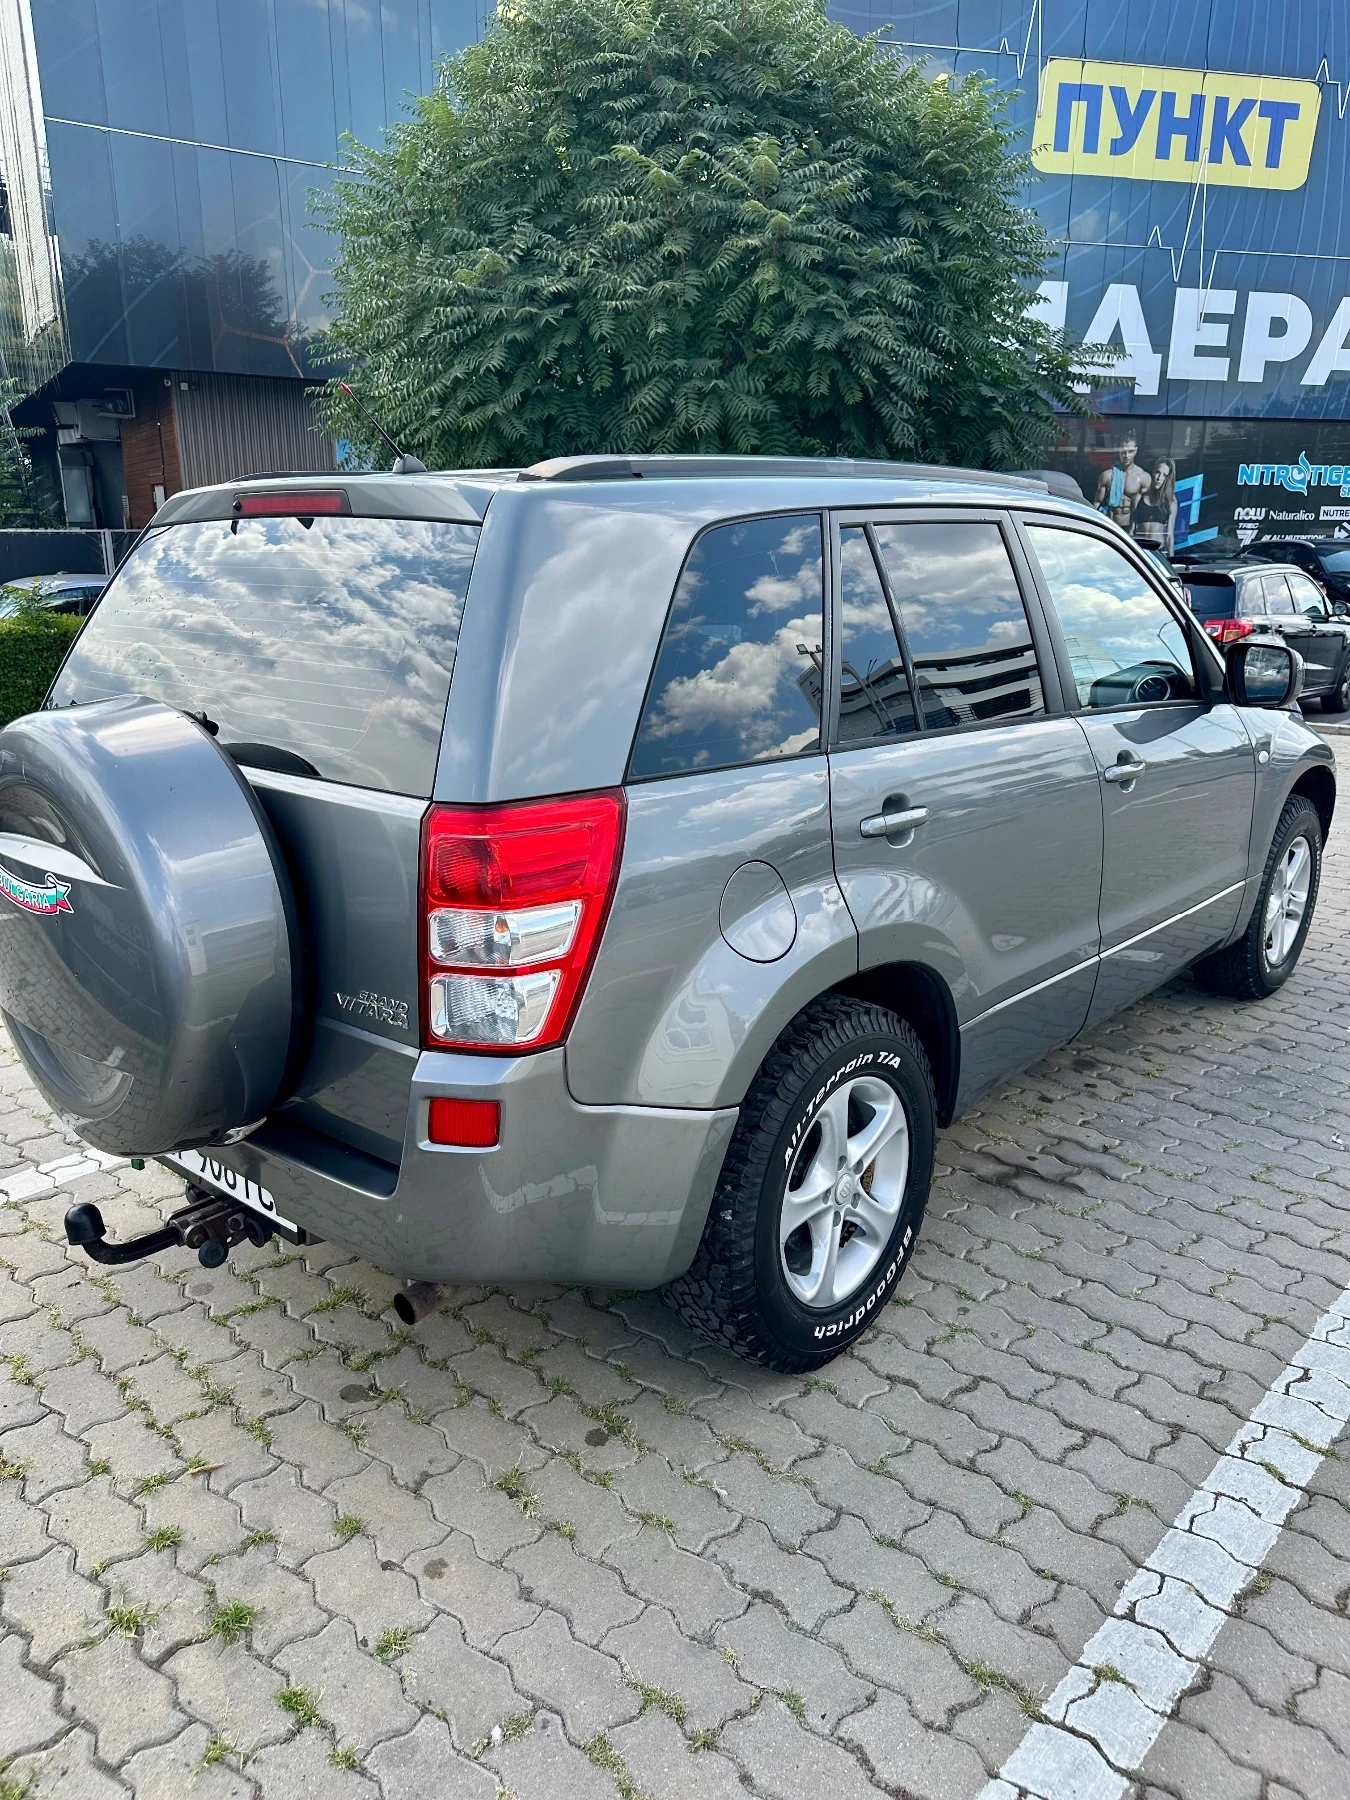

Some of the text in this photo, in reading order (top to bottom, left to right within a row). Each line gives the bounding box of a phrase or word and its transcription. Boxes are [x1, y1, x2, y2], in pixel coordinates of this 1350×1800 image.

[1053, 82, 1301, 169] ПУНКТ
[1269, 510, 1315, 520] Naturalico
[0, 872, 51, 910] ULGARIA
[334, 992, 409, 1030] VITARA
[359, 990, 409, 1014] GRAND
[785, 1051, 902, 1170] All-Terrain T/A
[814, 1225, 913, 1340] BFGoodrich
